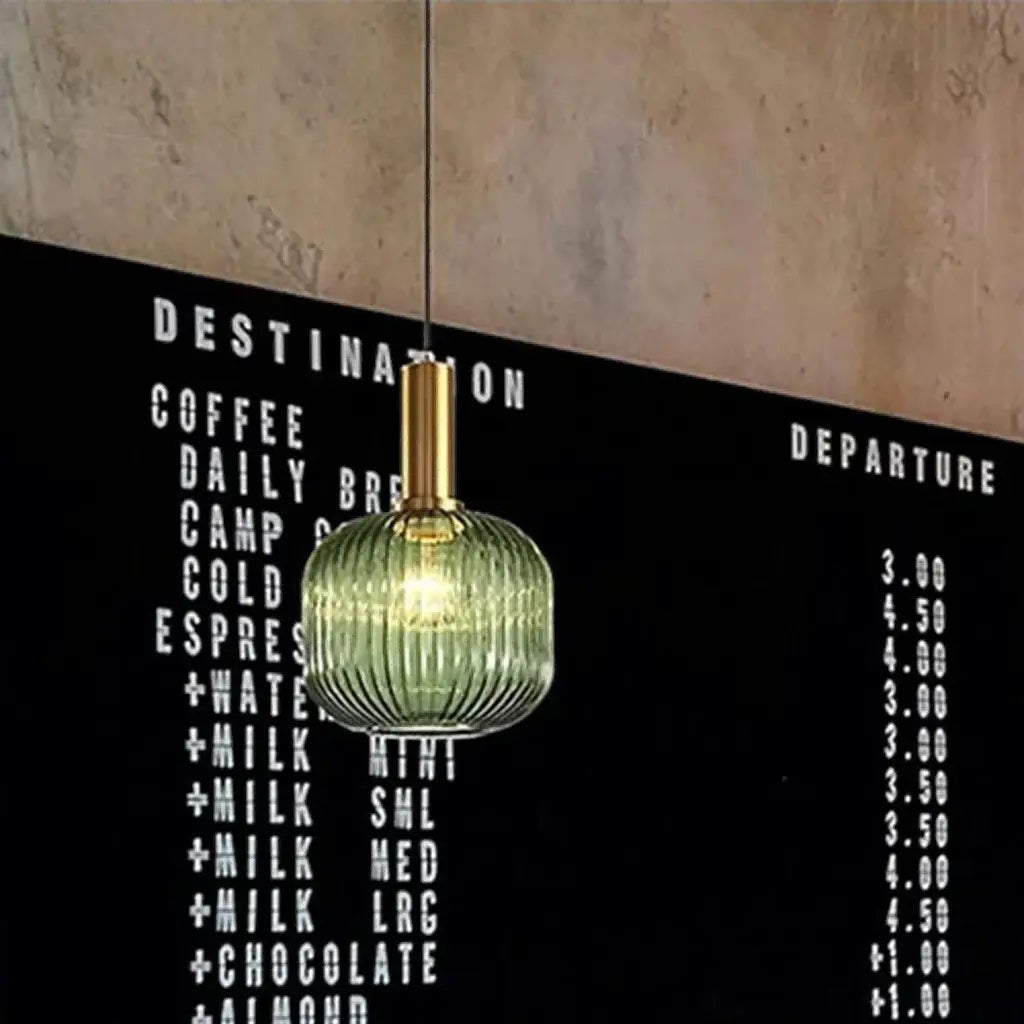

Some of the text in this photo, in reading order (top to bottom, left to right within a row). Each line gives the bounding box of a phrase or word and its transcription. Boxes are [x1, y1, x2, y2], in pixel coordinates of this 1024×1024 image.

[154, 297, 524, 410] DESTINAON
[151, 383, 304, 449] COFFEE
[180, 443, 305, 504] DAILY
[791, 422, 995, 495] DEPARTURE
[181, 499, 283, 555] CAMP
[183, 556, 282, 609] COLD
[882, 549, 945, 591] 3.00
[884, 593, 945, 634] 4.50
[884, 636, 946, 678] 4.00
[185, 669, 335, 721] +WATE
[884, 679, 947, 720] 3.00
[185, 723, 458, 780] +MILK MINI
[884, 723, 947, 762] 3.00
[187, 777, 434, 830] +MILK SML
[885, 767, 947, 805] 3.50
[885, 810, 948, 848] 3.50
[188, 832, 438, 883] +MILK MED
[886, 854, 948, 890] 4.00
[189, 888, 437, 935] +MILK LRG
[886, 897, 948, 933] 4.50
[190, 942, 436, 988] +CHOCOLATE
[870, 939, 949, 977] +1.00
[871, 983, 950, 1020] +1.00
